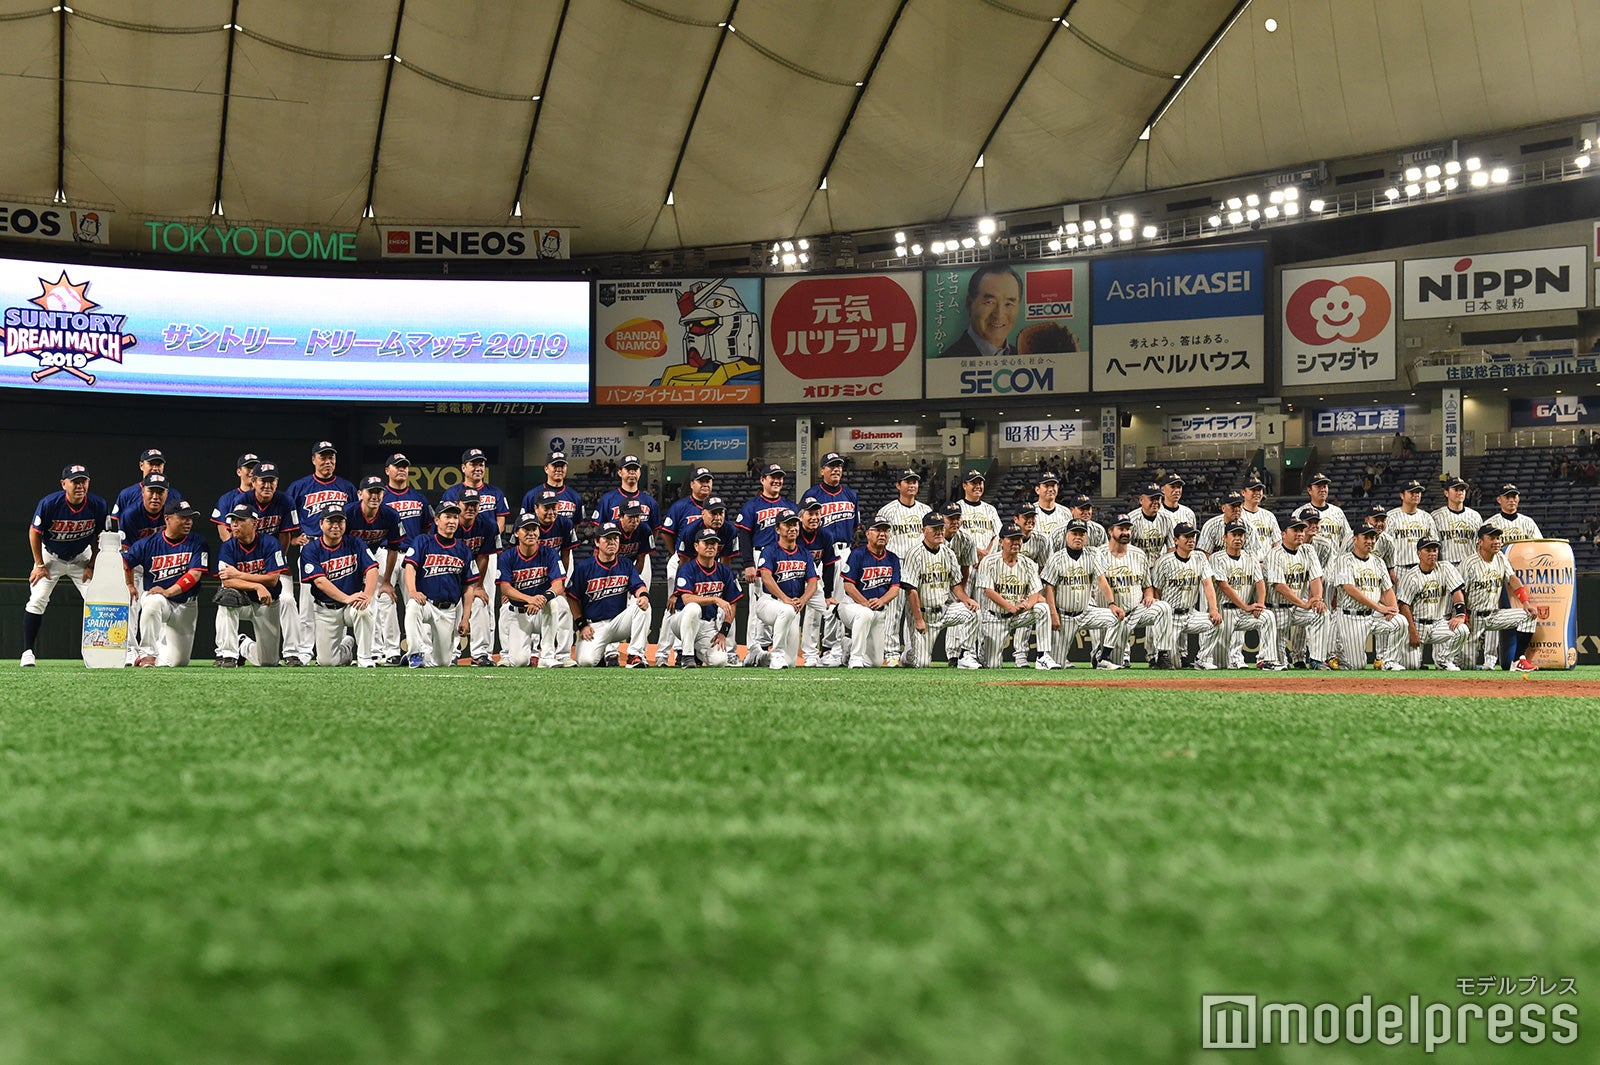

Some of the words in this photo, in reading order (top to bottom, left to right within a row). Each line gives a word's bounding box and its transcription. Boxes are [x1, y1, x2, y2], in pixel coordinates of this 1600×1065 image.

[144, 221, 257, 255] TOKYO
[265, 228, 357, 261] DOME
[415, 231, 526, 256] ENEOS
[1106, 270, 1250, 301] AsahiKASEI
[812, 294, 873, 325] 元気
[1028, 303, 1071, 316] SECOM
[1465, 297, 1525, 313] 日本製粉
[5, 309, 123, 332] SUNTORY
[6, 327, 64, 353] DREAM
[65, 331, 121, 362] MATCH
[162, 322, 297, 353] サントリー
[305, 327, 482, 358] ドリームマッチ
[483, 332, 569, 358] 2019
[616, 331, 660, 341] BANDAI
[616, 341, 660, 350] NAMCO
[40, 352, 87, 368] 2019
[1106, 350, 1250, 376] ヘーベルハウス
[1297, 347, 1379, 373] シマダヤ
[1446, 362, 1531, 380] 住設総合商社
[960, 367, 1054, 394] SECOM
[606, 389, 695, 402] バンダイナムコ
[699, 388, 751, 402] グループ
[803, 382, 884, 398] オロナミンC
[424, 403, 474, 414] 三菱電機
[1536, 402, 1588, 417] GALA
[1171, 415, 1253, 432] ニッテイライフ
[1268, 422, 1274, 434] 1
[1316, 408, 1400, 432] 日総工産
[851, 429, 903, 440] Bishamon
[949, 435, 956, 447] 3
[1005, 423, 1076, 442] 昭和大学
[571, 445, 621, 458] 黒ラベル
[647, 442, 661, 453] 34
[404, 466, 490, 491] RYOI
[1515, 567, 1573, 585] REMIUM
